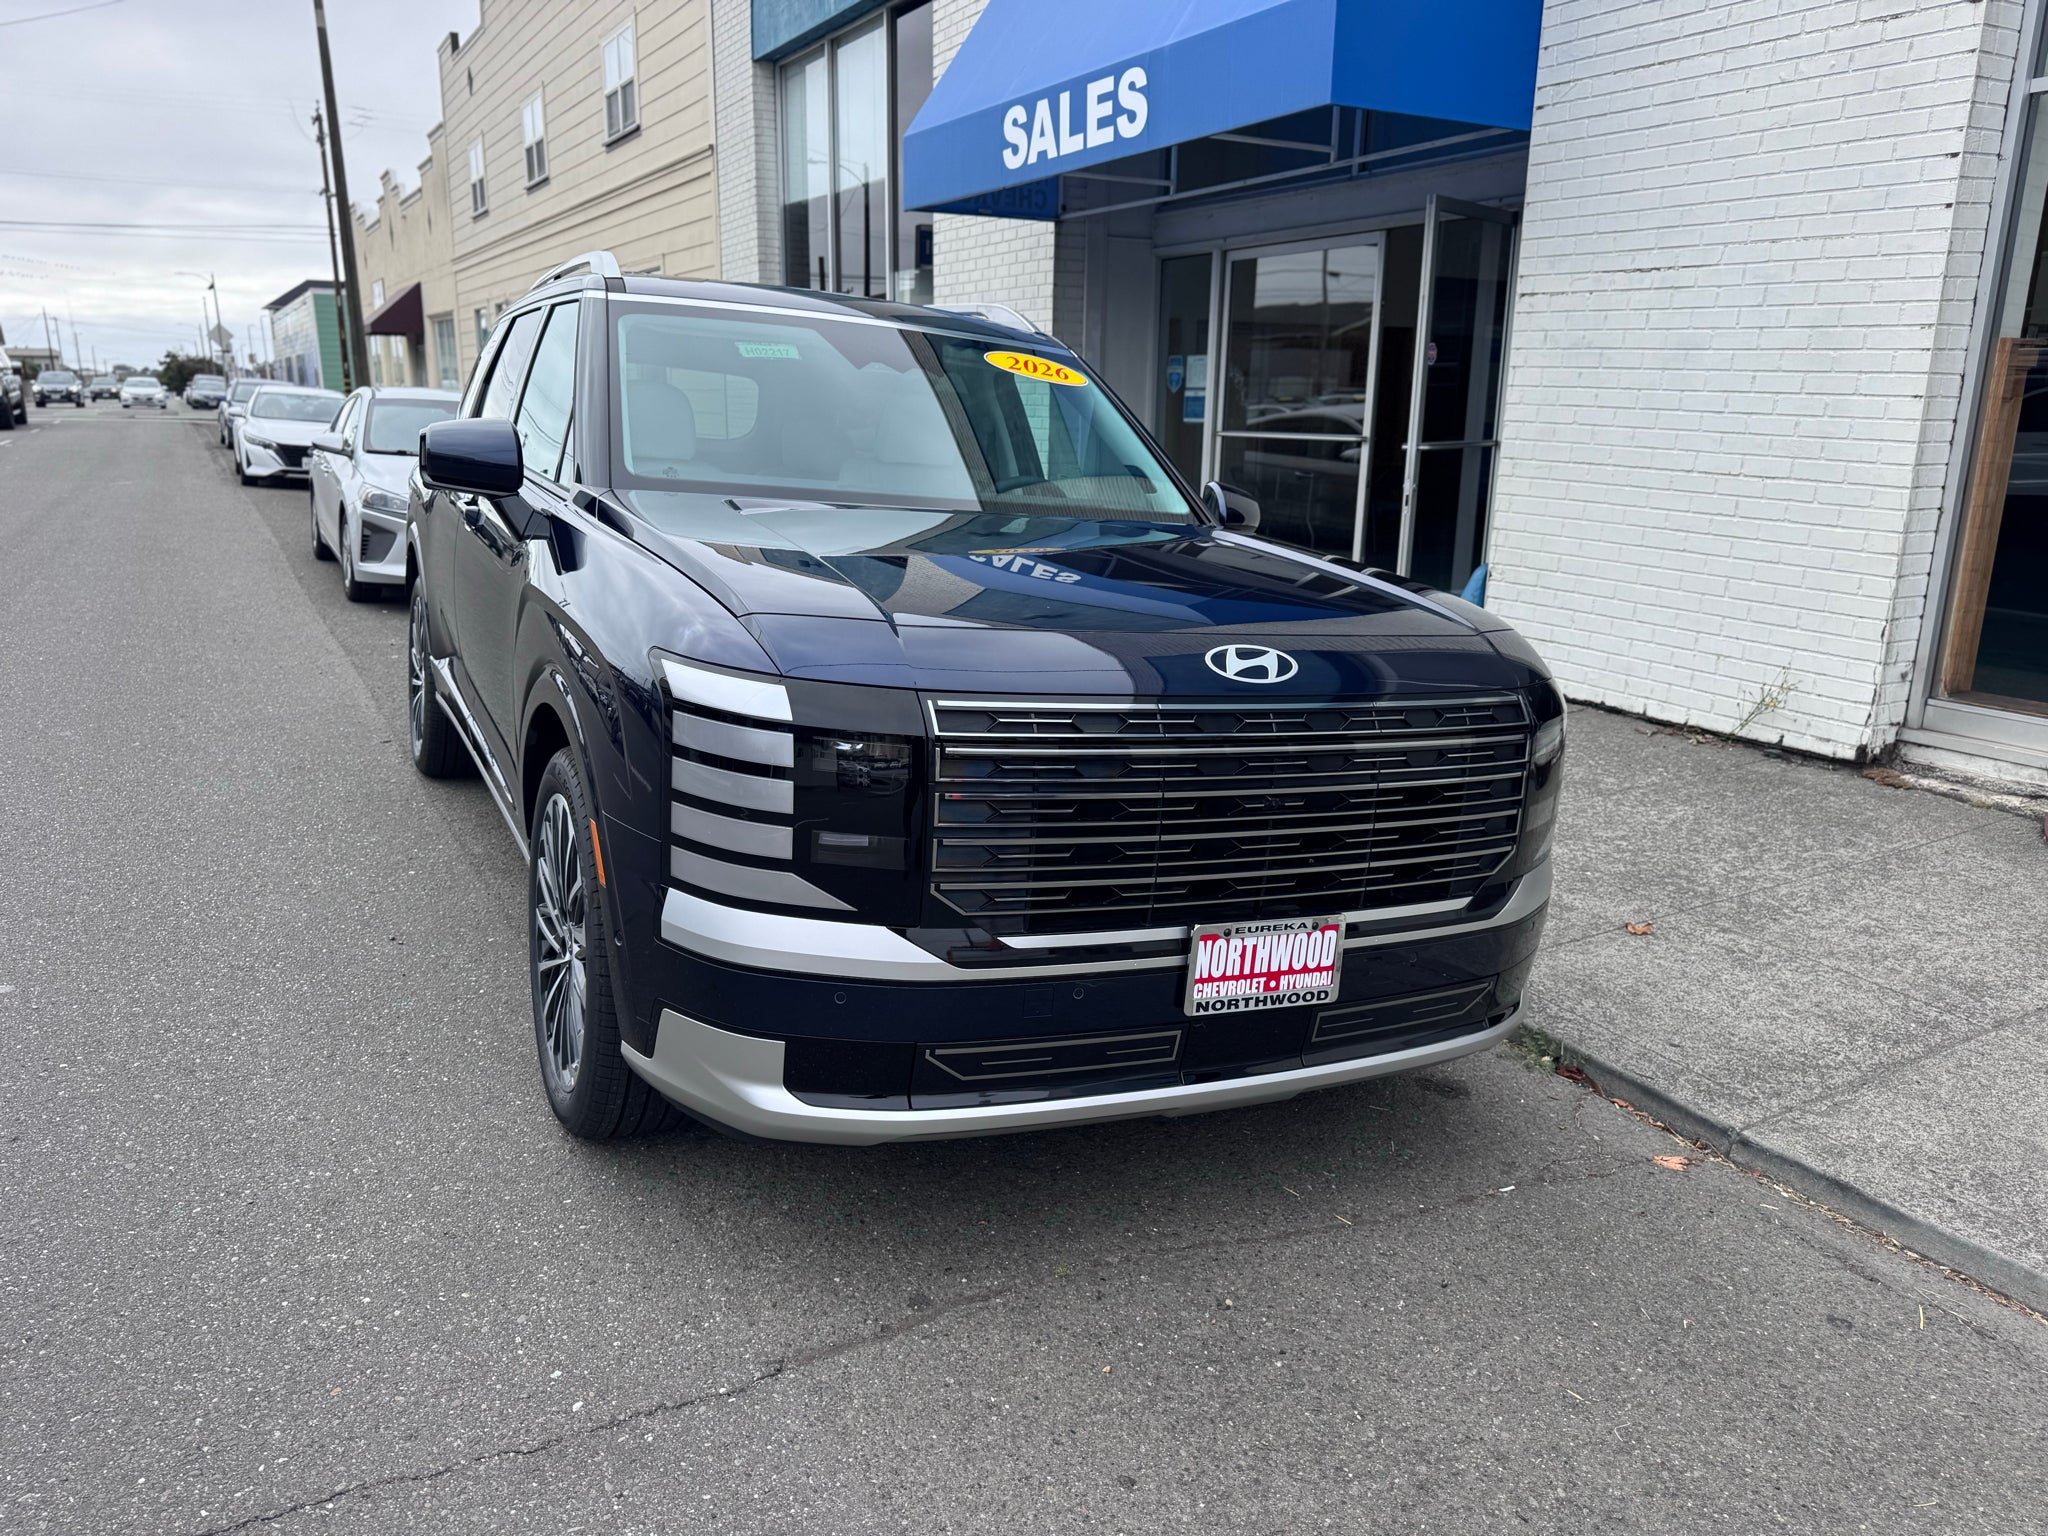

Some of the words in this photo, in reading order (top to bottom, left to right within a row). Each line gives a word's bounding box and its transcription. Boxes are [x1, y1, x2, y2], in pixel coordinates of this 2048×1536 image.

[1002, 66, 1148, 170] SALES
[1006, 356, 1069, 380] 2026
[1235, 922, 1308, 934] EUREKA
[1195, 930, 1337, 979] NORTHWOOD
[1194, 977, 1267, 998] CHEVROLET
[1279, 971, 1332, 990] HYUNDAI
[1195, 990, 1329, 1013] NORTHWOOD
